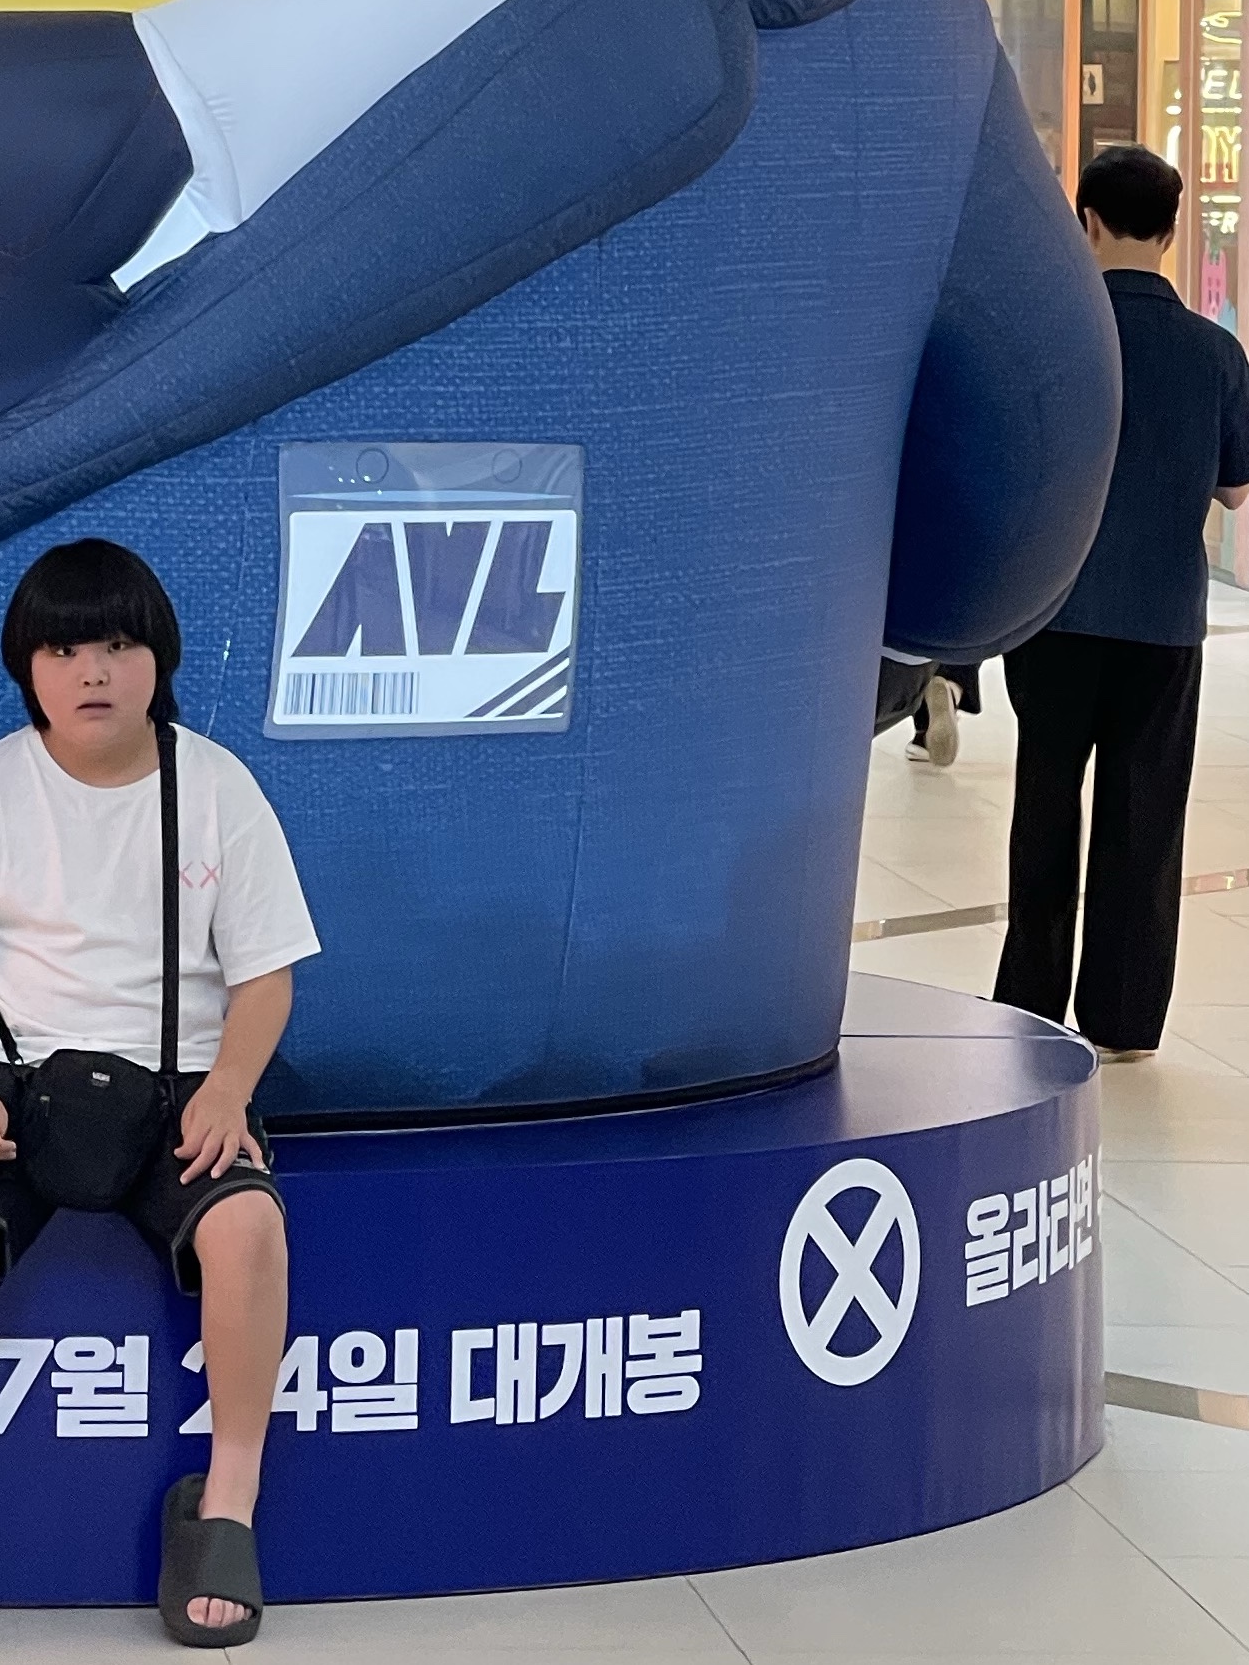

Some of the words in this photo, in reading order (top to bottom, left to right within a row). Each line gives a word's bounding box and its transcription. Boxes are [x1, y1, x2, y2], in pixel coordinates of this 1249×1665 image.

[290, 520, 566, 657] AVL
[964, 1154, 1093, 1307] 올라타면
[449, 1308, 703, 1425] 대개봉
